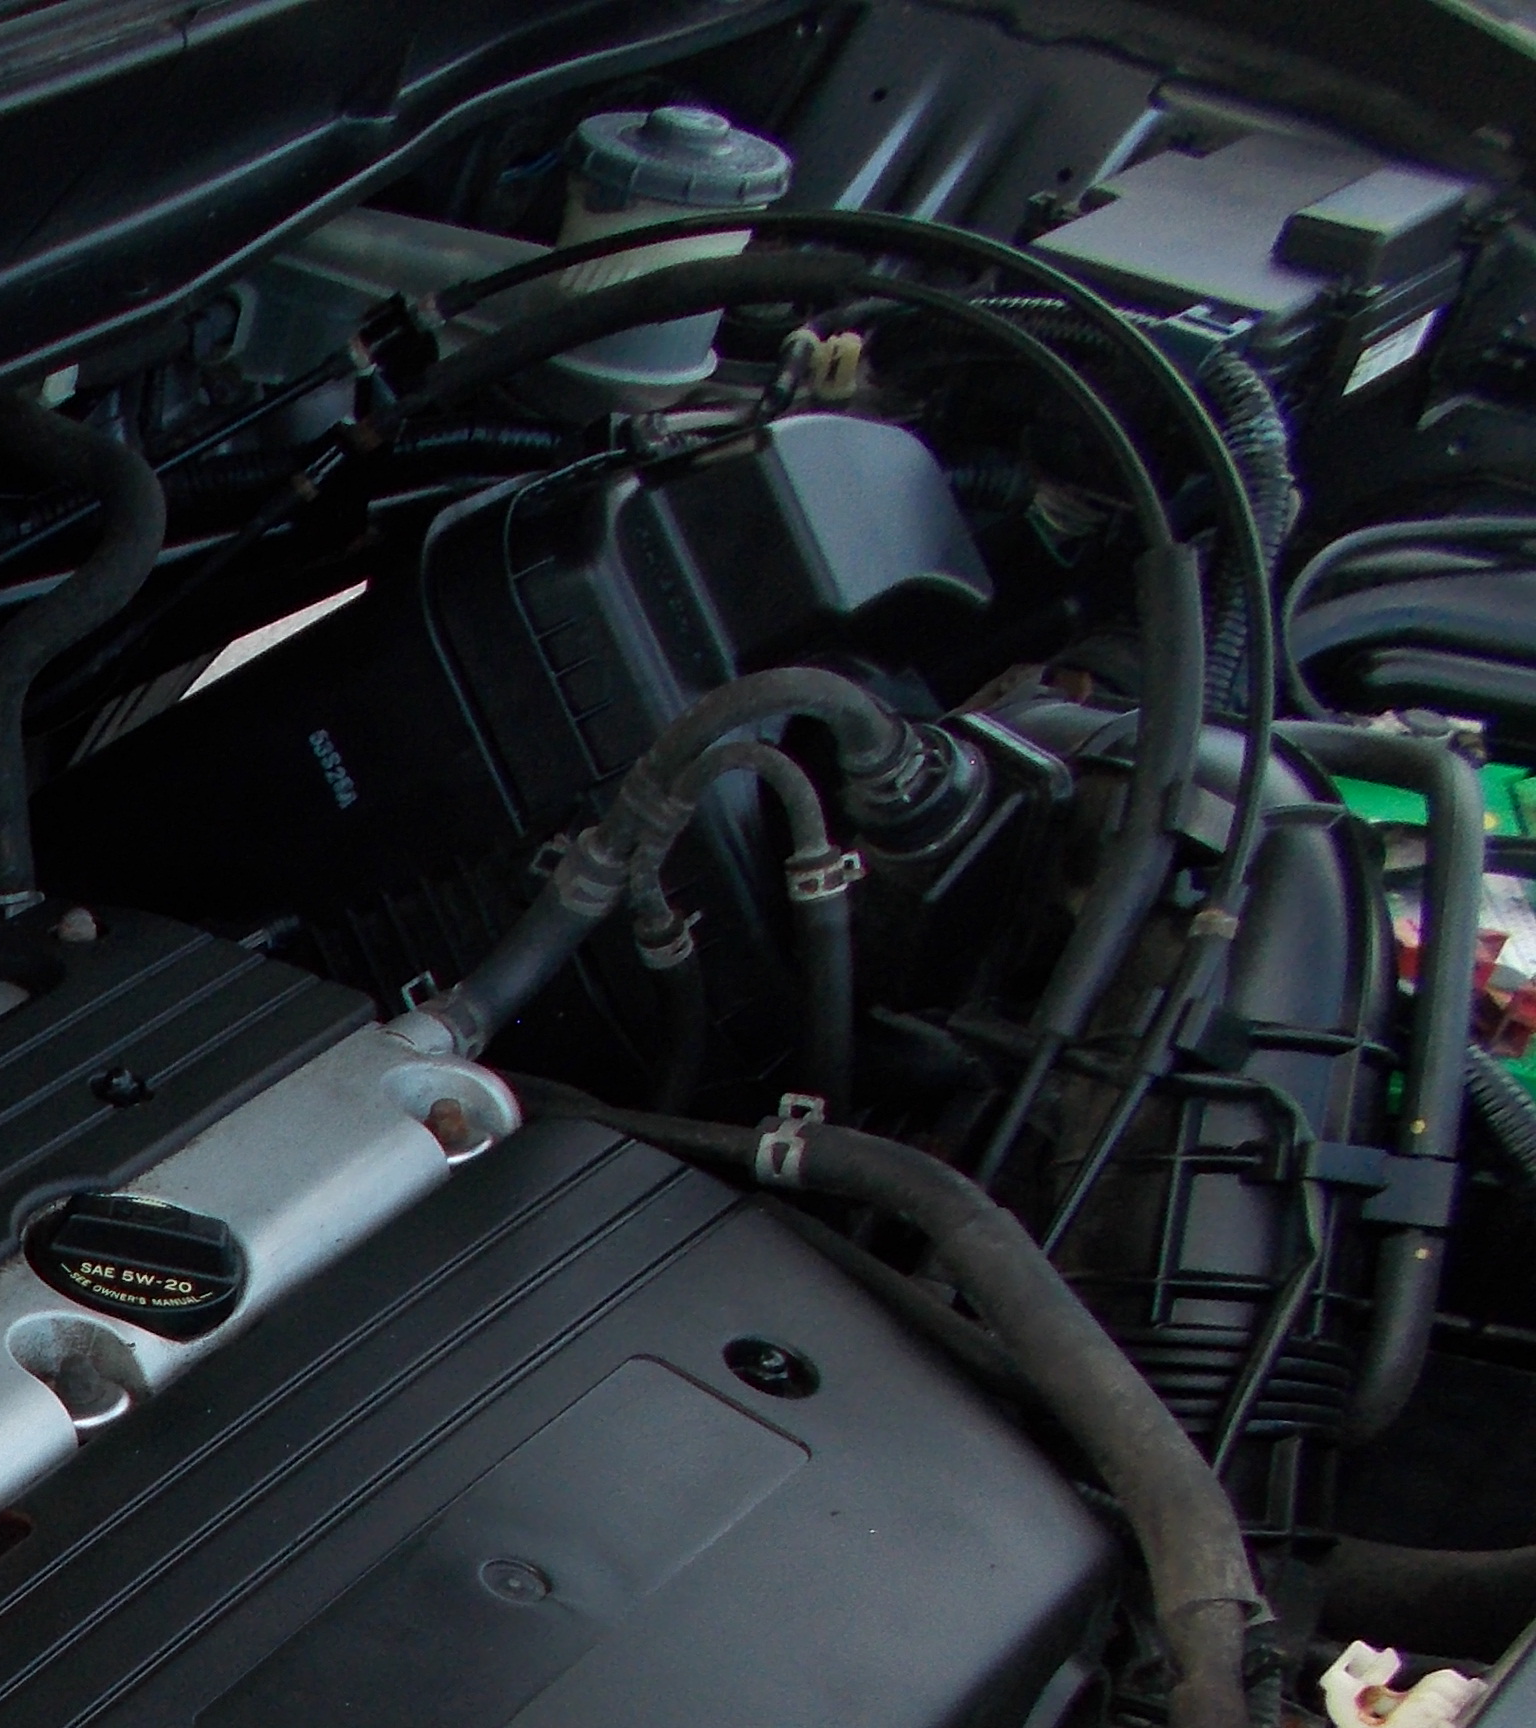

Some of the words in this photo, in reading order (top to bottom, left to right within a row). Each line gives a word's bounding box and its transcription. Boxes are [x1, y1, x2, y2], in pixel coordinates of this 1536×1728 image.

[69, 1271, 92, 1287] SEE
[92, 1284, 147, 1305] OWNER'S
[151, 1295, 201, 1306] MANUAL
[80, 1262, 115, 1279] SAE
[122, 1270, 192, 1294] 5W-20
